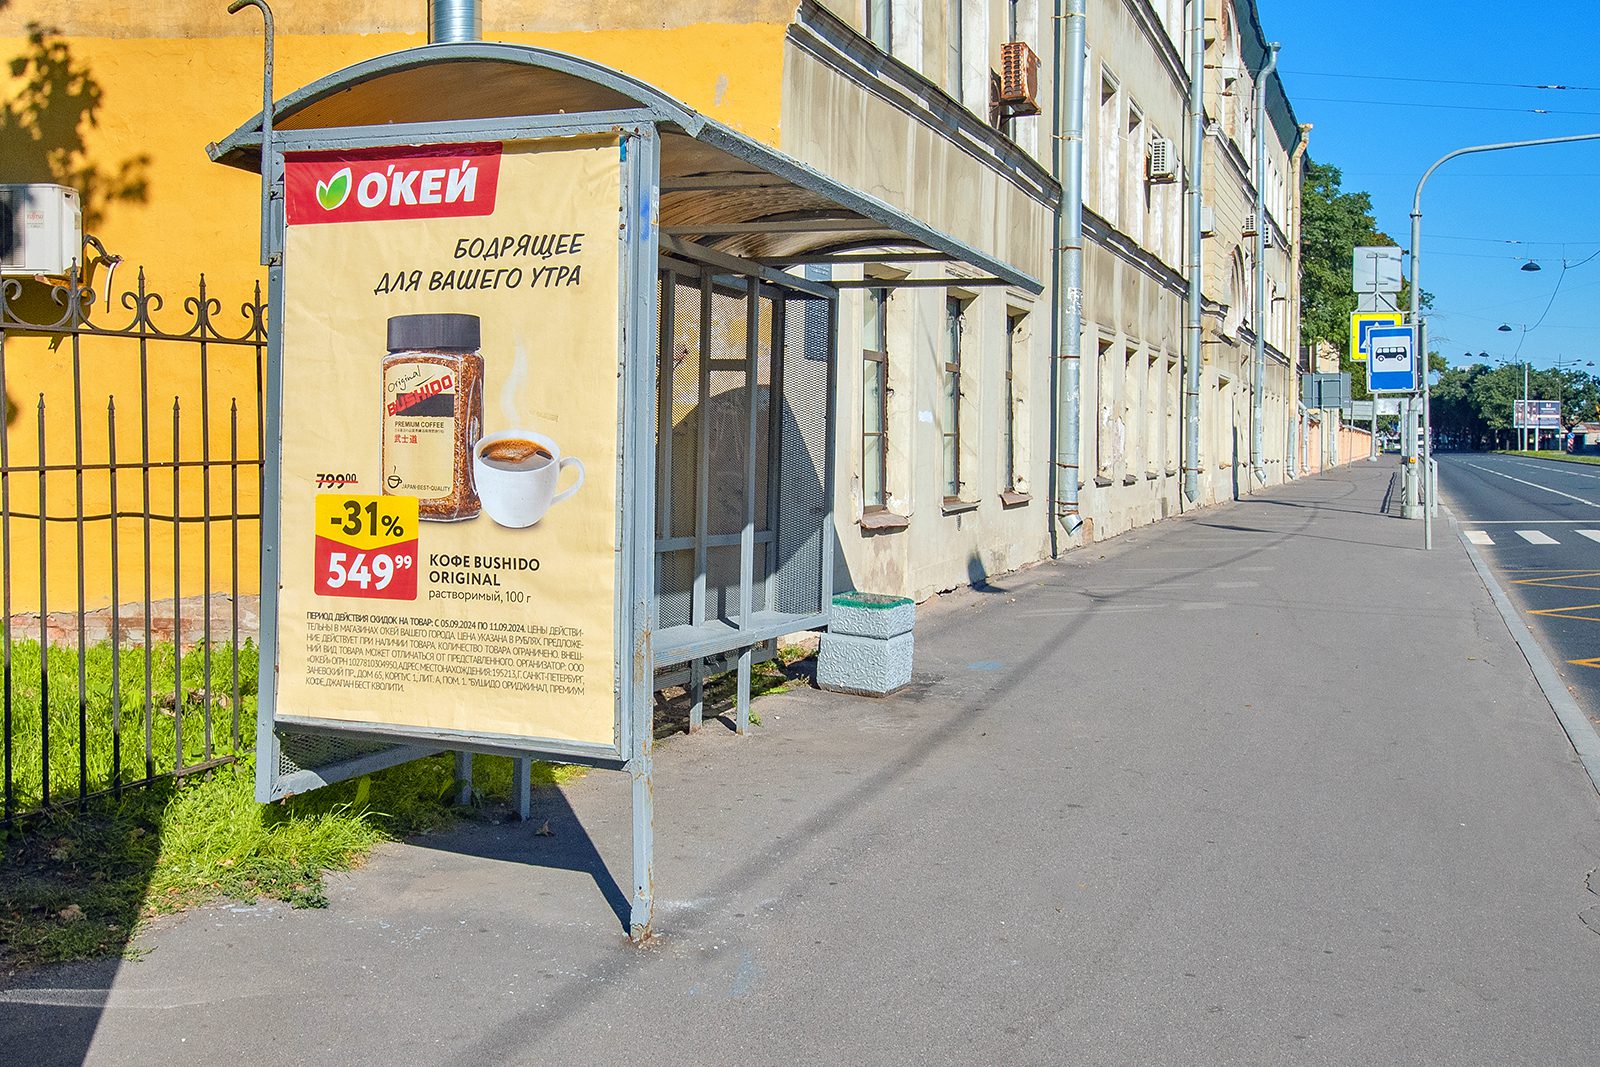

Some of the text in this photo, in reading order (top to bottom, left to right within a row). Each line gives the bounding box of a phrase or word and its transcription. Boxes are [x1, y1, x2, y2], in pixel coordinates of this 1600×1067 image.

[454, 233, 585, 261] БОДРЯЩЕЕ
[374, 264, 582, 297] ДЛЯ ВАШЕГО УТРА
[388, 366, 421, 392] Original
[387, 375, 453, 416] BUSHIDO
[394, 420, 444, 429] PREMIUM COFFEE
[394, 434, 418, 445] 武士道
[330, 500, 404, 538] -31%
[429, 553, 541, 572] КОФЕ BUSHIDO
[428, 571, 501, 587] ORIGINAL
[428, 588, 532, 604] растворимый, 100 г
[306, 611, 333, 622] ПЕРИОД
[334, 612, 369, 622] ДЕЙСТВИЯ
[370, 614, 398, 624] СКИДОК
[399, 616, 409, 625] НА
[410, 617, 434, 626] ТОВАР:
[434, 618, 440, 628] С
[440, 620, 476, 630] 05.09.2024
[478, 622, 488, 630] ПО
[527, 624, 548, 635] ЦЕНЫ
[549, 626, 584, 636] ДЕЙСТВИ-
[306, 622, 333, 632] ТЕЛЬНЫ
[340, 624, 378, 634] МАГАЗИНАХ
[400, 628, 428, 638] ВАШЕГО
[457, 632, 476, 641] ЦЕНА
[478, 633, 508, 643] УКАЗАНА
[543, 638, 584, 648] ПРЕДЛОЖЕ-
[306, 633, 320, 642] НИЕ
[322, 634, 358, 644] ДЕЙСТВУЕТ
[359, 636, 374, 645] ПРИ
[375, 638, 408, 648] НАЛИЧИИ
[438, 642, 483, 652] КОЛИЧЕСТВО
[485, 644, 511, 655] ТОВАРА
[512, 646, 560, 658] ОГРАНИЧЕНО.
[560, 650, 584, 660] ВНЕШ-
[306, 643, 584, 672] НИЙ ВИД ТОВАРА МОЖЕТ ОТЛИЧАТЬСЯ ОТ ПРЕДСТАВЛЕННОГО. ОРГАНИЗАТОР: ООО
[332, 656, 348, 666] ОГРН
[306, 666, 344, 676] ЗАНЕВСКИЙ
[357, 670, 373, 678] ДОМ
[385, 672, 412, 681] КОРПУС
[550, 684, 584, 695] ПРЕМИУМ
[326, 678, 354, 688] ДЖАПАН
[355, 680, 370, 690] БЕСТ
